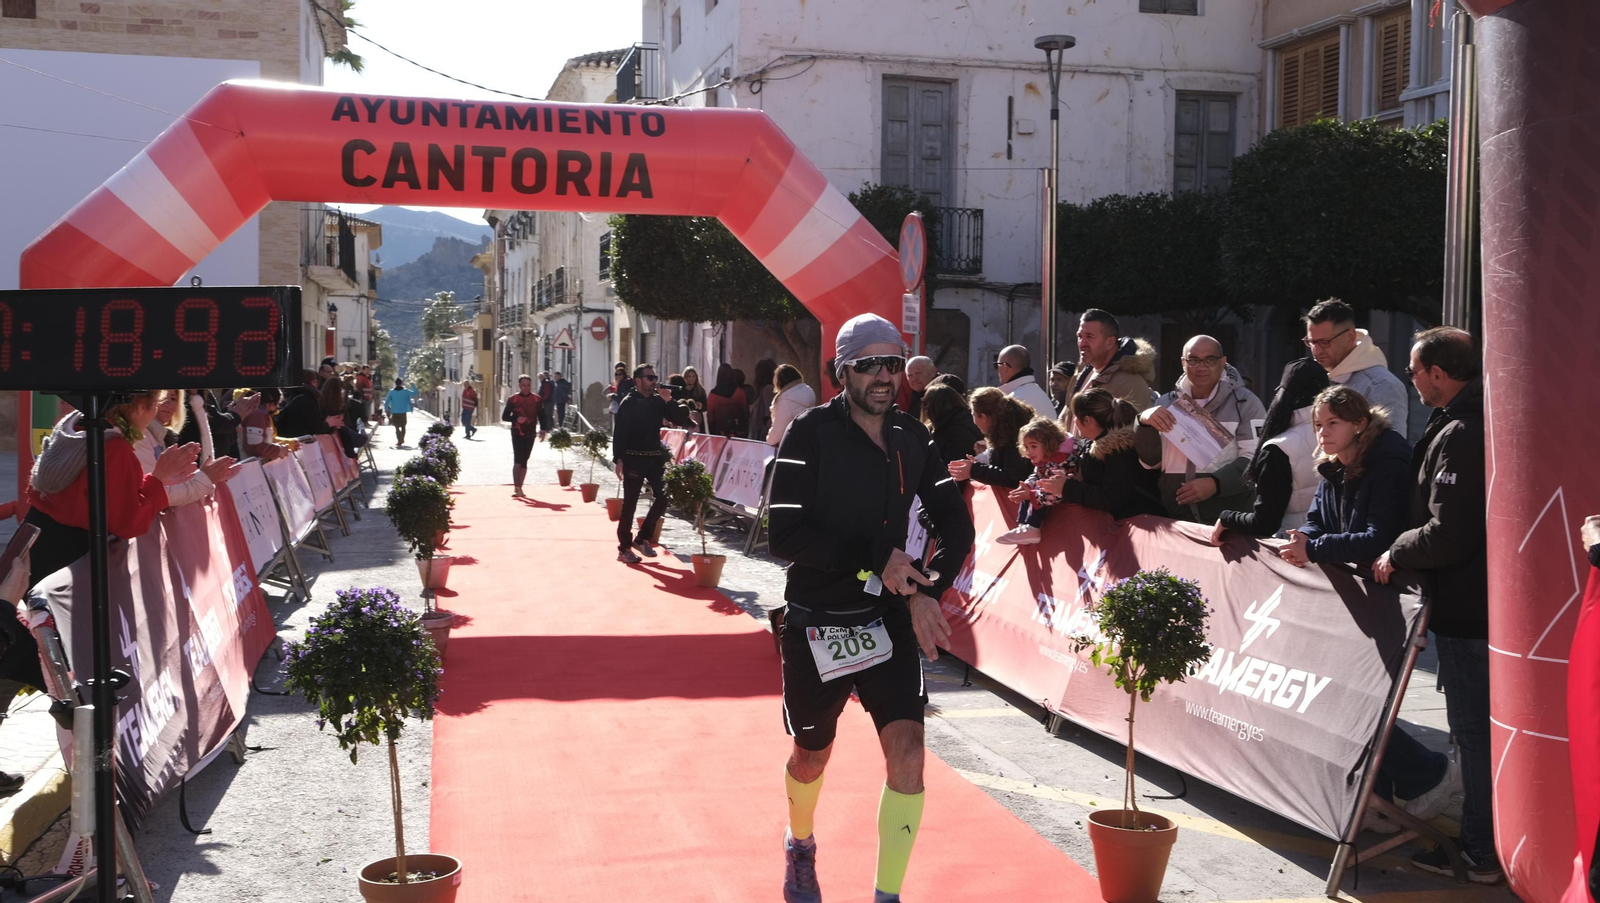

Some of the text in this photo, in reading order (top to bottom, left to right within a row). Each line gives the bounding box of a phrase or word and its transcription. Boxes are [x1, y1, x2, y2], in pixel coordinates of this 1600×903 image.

[331, 95, 666, 138] AYUNTAMIENTO
[340, 138, 654, 199] CANTORIA
[828, 632, 876, 661] 208
[1186, 643, 1333, 714] AMERGY
[1185, 700, 1265, 742] www.teamergy.es
